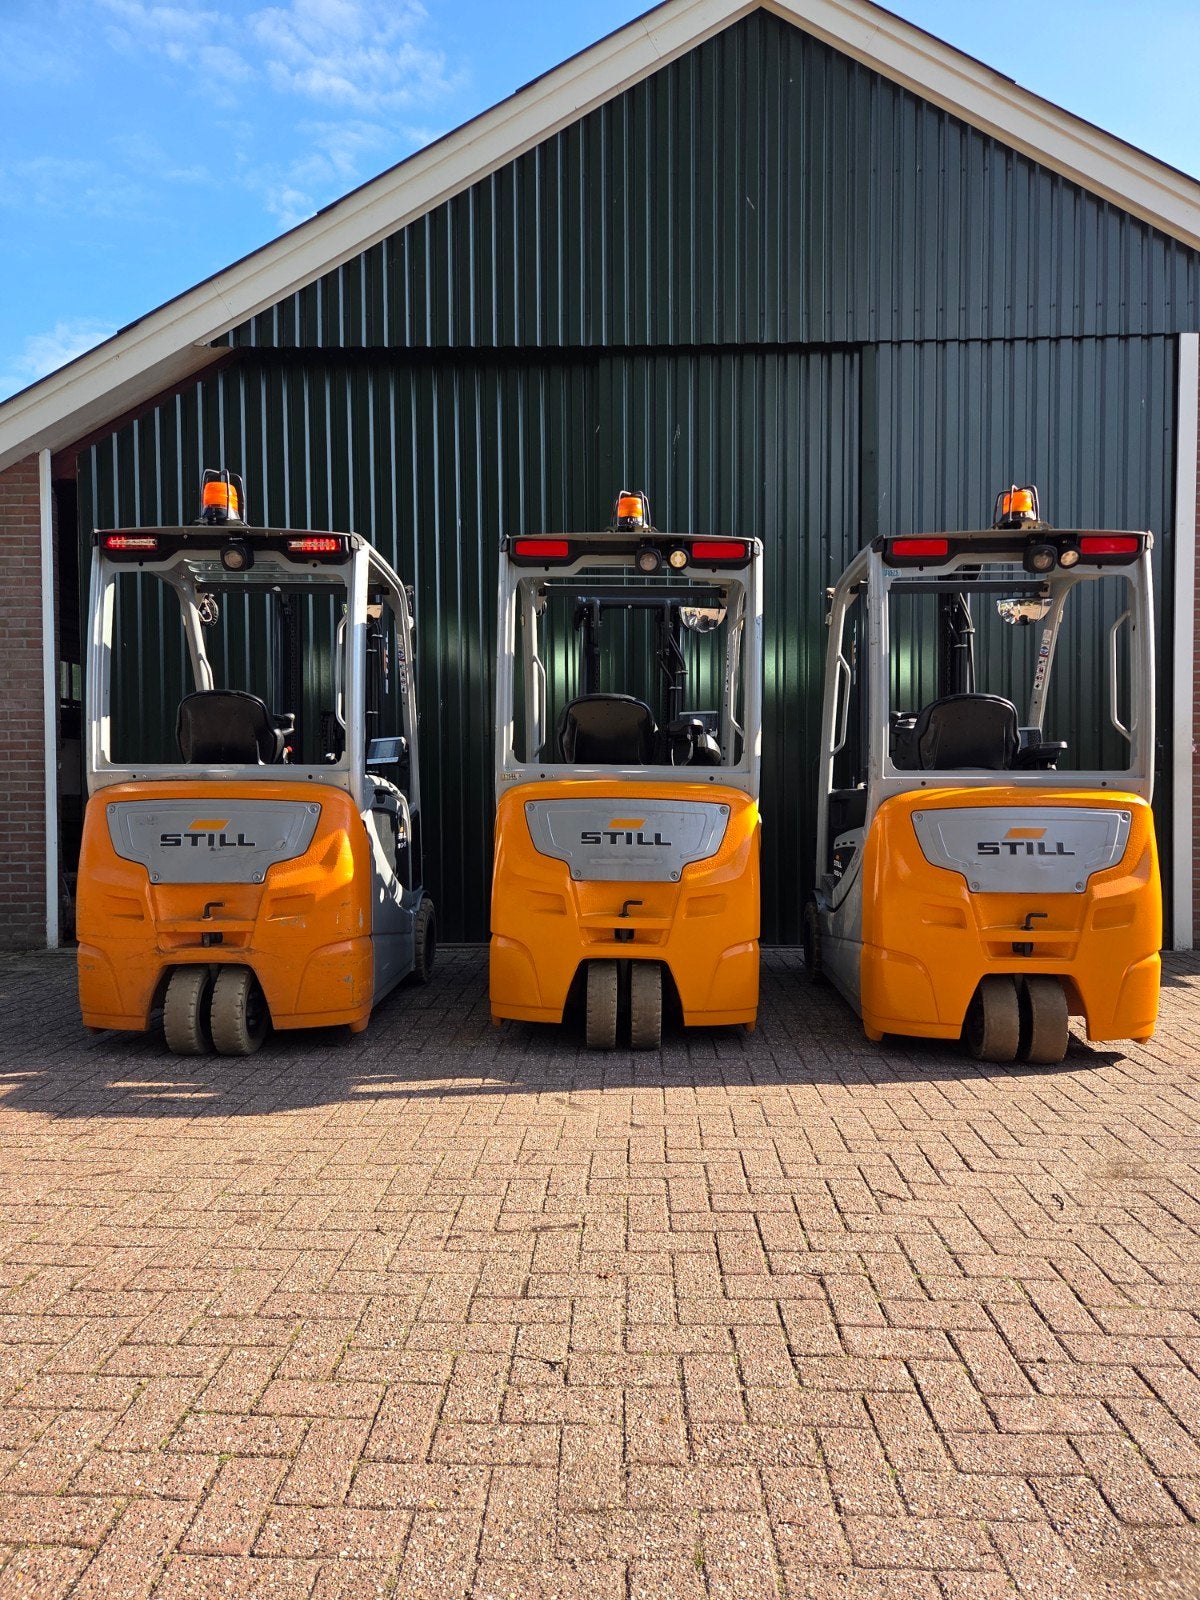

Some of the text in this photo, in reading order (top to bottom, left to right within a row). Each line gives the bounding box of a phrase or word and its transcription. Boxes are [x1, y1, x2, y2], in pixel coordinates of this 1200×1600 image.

[160, 833, 256, 847] STILL
[581, 831, 672, 846] STILL
[977, 842, 1075, 856] STILL
